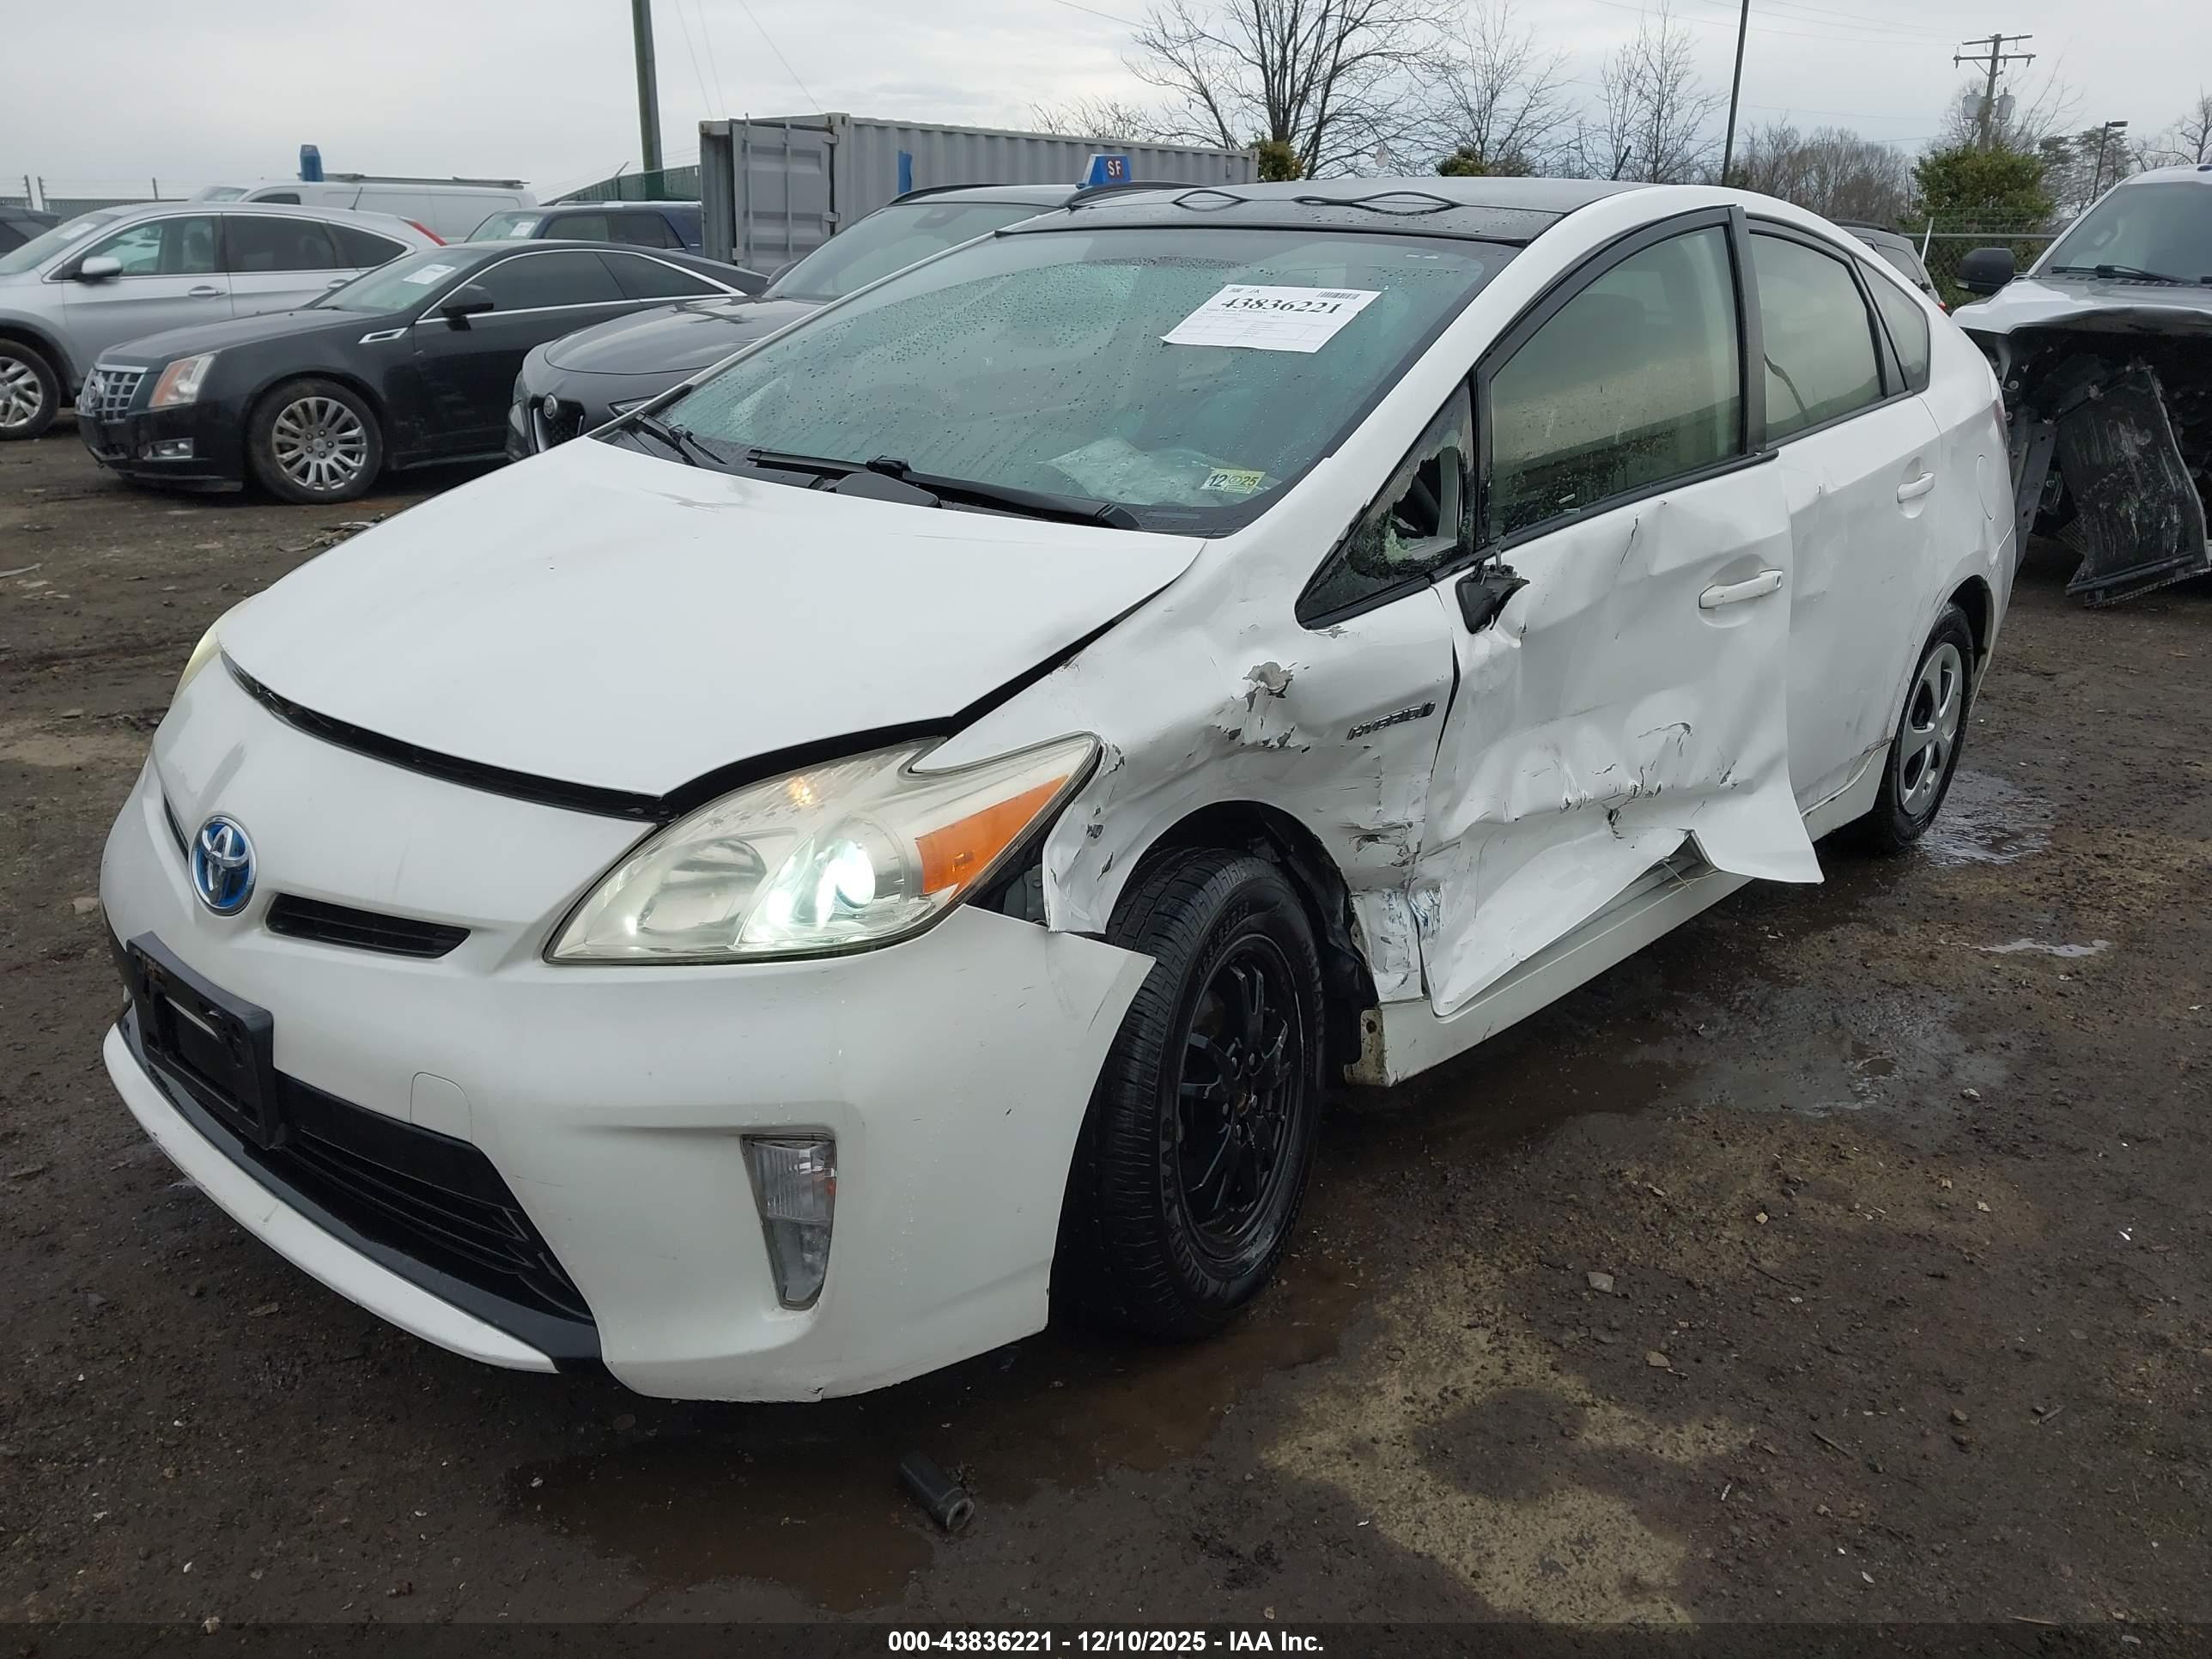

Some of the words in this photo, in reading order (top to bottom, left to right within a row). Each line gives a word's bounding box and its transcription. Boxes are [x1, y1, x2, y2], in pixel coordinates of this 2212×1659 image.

[1107, 160, 1121, 177] SF
[1221, 296, 1344, 315] 43836221
[1208, 473, 1228, 488] 12
[1241, 475, 1260, 487] 25
